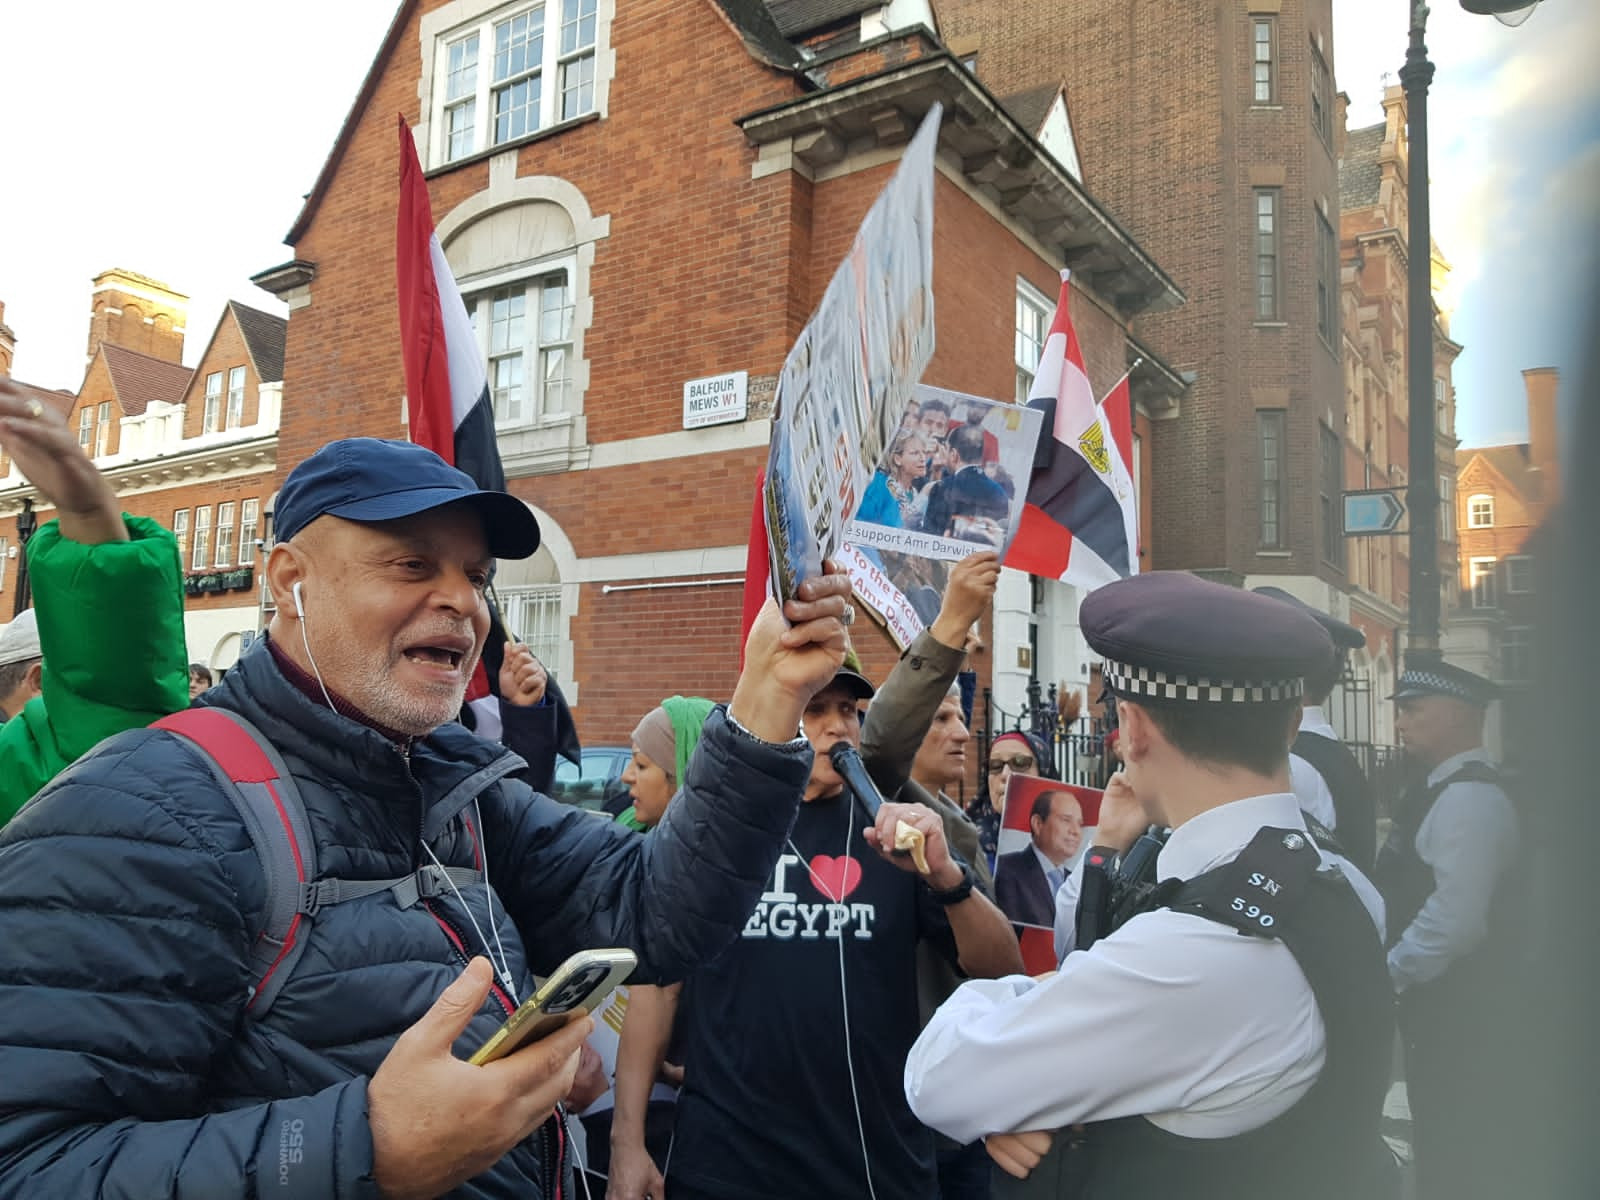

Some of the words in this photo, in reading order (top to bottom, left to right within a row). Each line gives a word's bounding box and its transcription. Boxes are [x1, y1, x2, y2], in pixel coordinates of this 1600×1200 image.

[689, 396, 719, 412] MEWS
[722, 393, 737, 406] W1
[690, 379, 734, 397] BALFOUR
[856, 527, 900, 544] support
[904, 535, 929, 549] Amr
[854, 551, 867, 570] to
[870, 567, 890, 593] the
[893, 590, 922, 632] Exclu
[854, 577, 883, 607] Amr
[761, 854, 798, 902] I
[1248, 873, 1281, 896] SN
[742, 902, 875, 937] EGYPT
[1231, 897, 1274, 927] 590
[280, 1120, 290, 1185] DOWNPRO
[288, 1119, 304, 1164] 550
